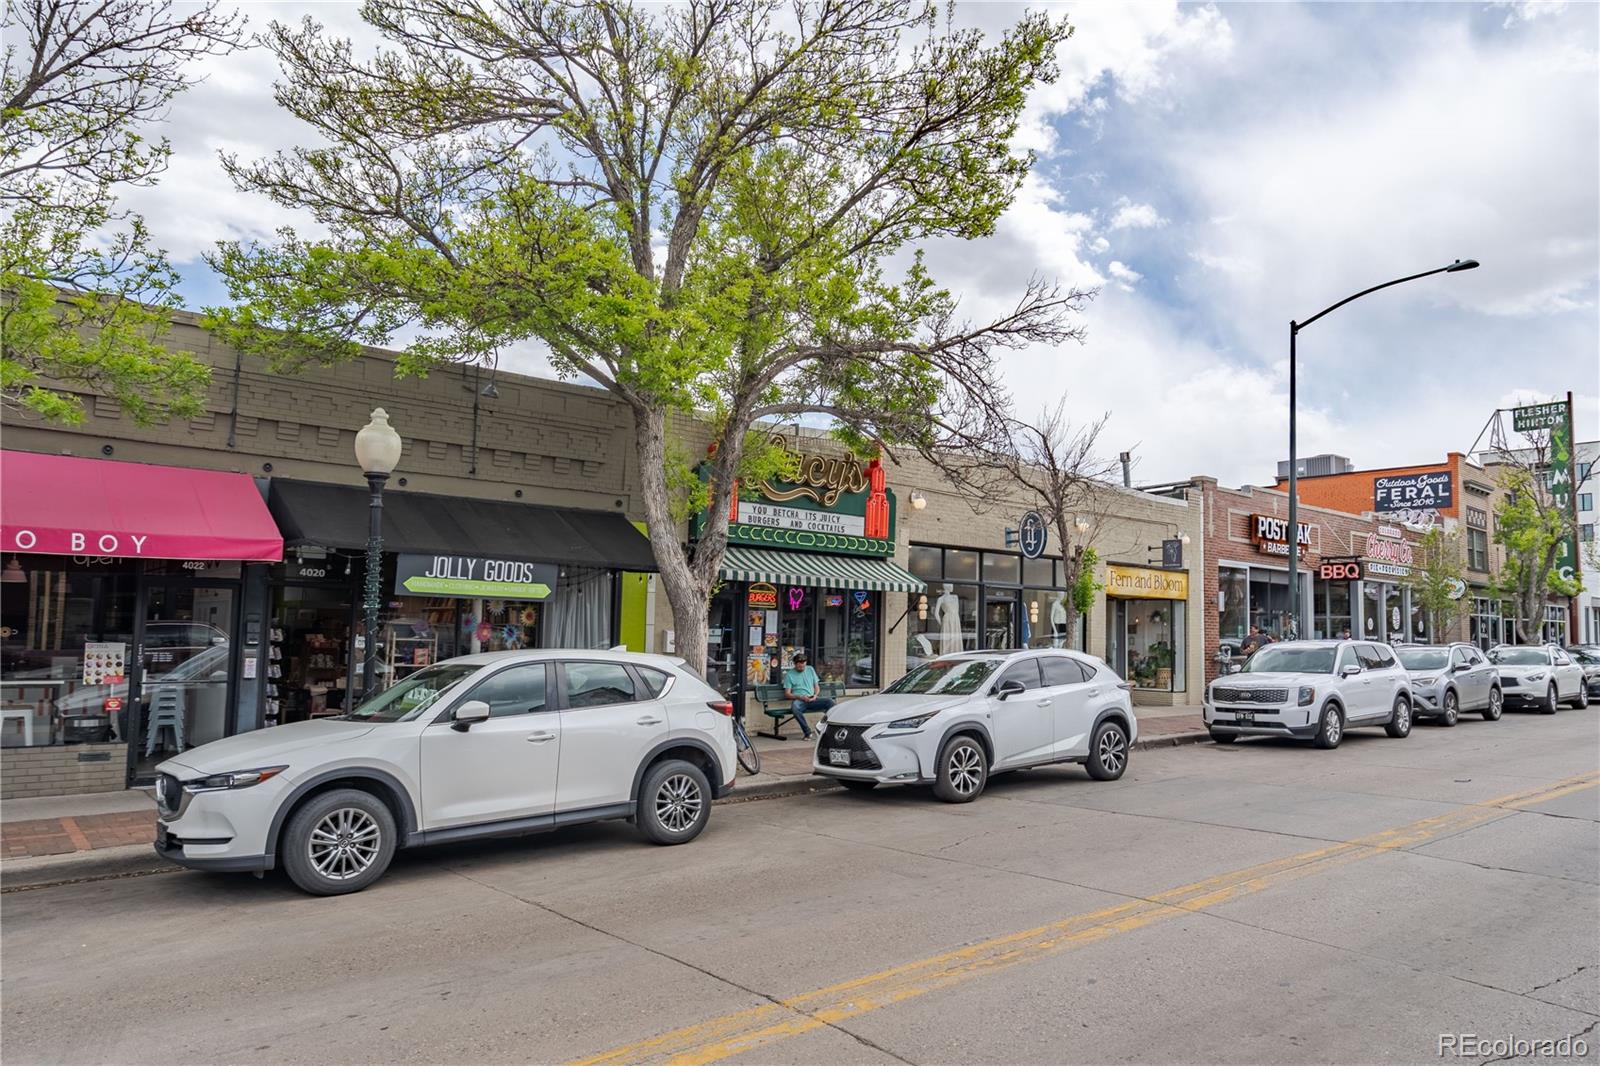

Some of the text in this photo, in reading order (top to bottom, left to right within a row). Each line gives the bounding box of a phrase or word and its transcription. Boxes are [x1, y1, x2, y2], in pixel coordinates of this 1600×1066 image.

[1515, 404, 1566, 418] FLESHER
[1376, 474, 1449, 489] Outdoor Goods
[1376, 484, 1450, 501] FERAL
[1390, 500, 1411, 508] Since
[752, 505, 840, 523] YOU BETCHA ITS JUICY
[748, 515, 845, 534] BURGERS AND COCKTAILS
[1257, 516, 1312, 545] POST AK
[1552, 468, 1575, 582] MUIC
[71, 532, 148, 554] BOY
[1267, 542, 1302, 557] BARBEE
[1366, 532, 1399, 563] Cherry
[182, 561, 205, 570] 4022
[300, 567, 326, 578] 4020
[425, 556, 534, 583] JOLLY GOODS
[1320, 563, 1360, 579] BBQ
[1110, 570, 1184, 592] Fern and Bloom
